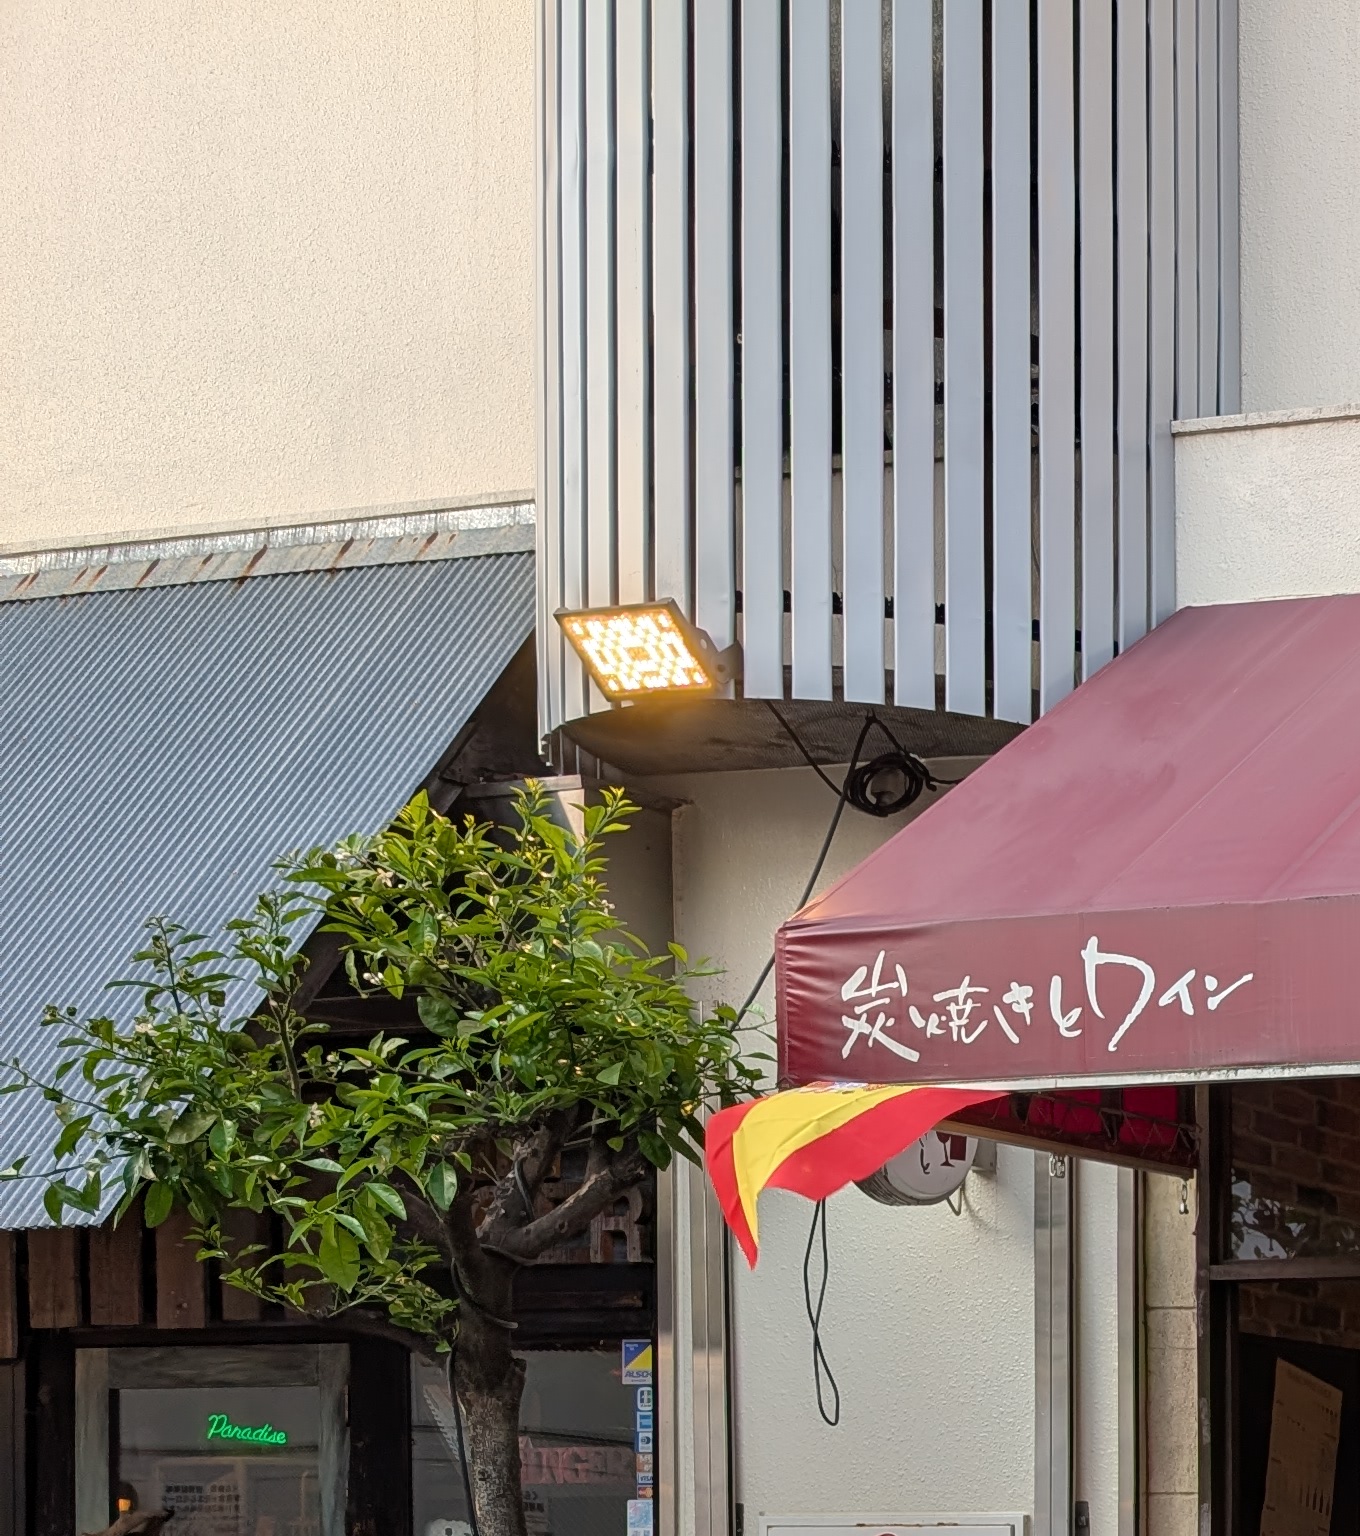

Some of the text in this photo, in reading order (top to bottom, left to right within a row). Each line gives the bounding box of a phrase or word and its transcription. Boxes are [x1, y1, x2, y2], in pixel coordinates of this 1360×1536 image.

[841, 935, 1254, 1063] 炭焼きとワイン
[208, 1414, 288, 1444] Paradise
